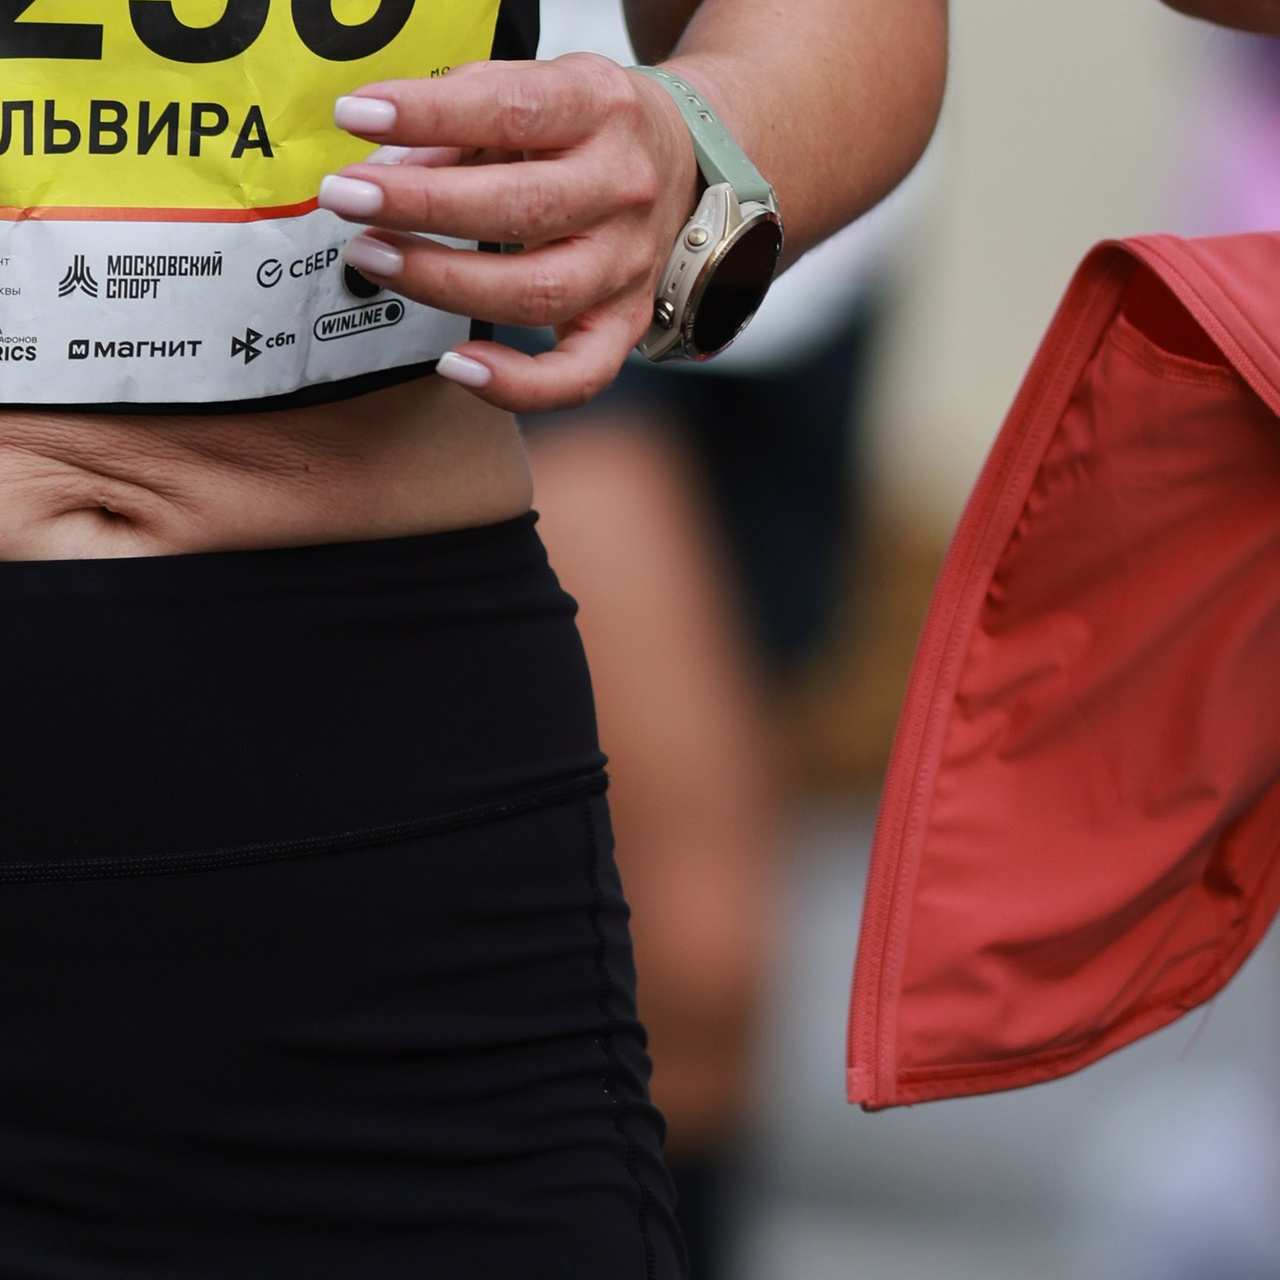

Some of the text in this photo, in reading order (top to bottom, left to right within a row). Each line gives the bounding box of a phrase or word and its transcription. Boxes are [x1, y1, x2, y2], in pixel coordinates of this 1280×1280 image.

[107, 251, 223, 277] МОСКОВСКИЙ
[289, 247, 339, 278] СБЕР
[106, 278, 161, 299] СПОРТ
[321, 307, 383, 335] WINLINE
